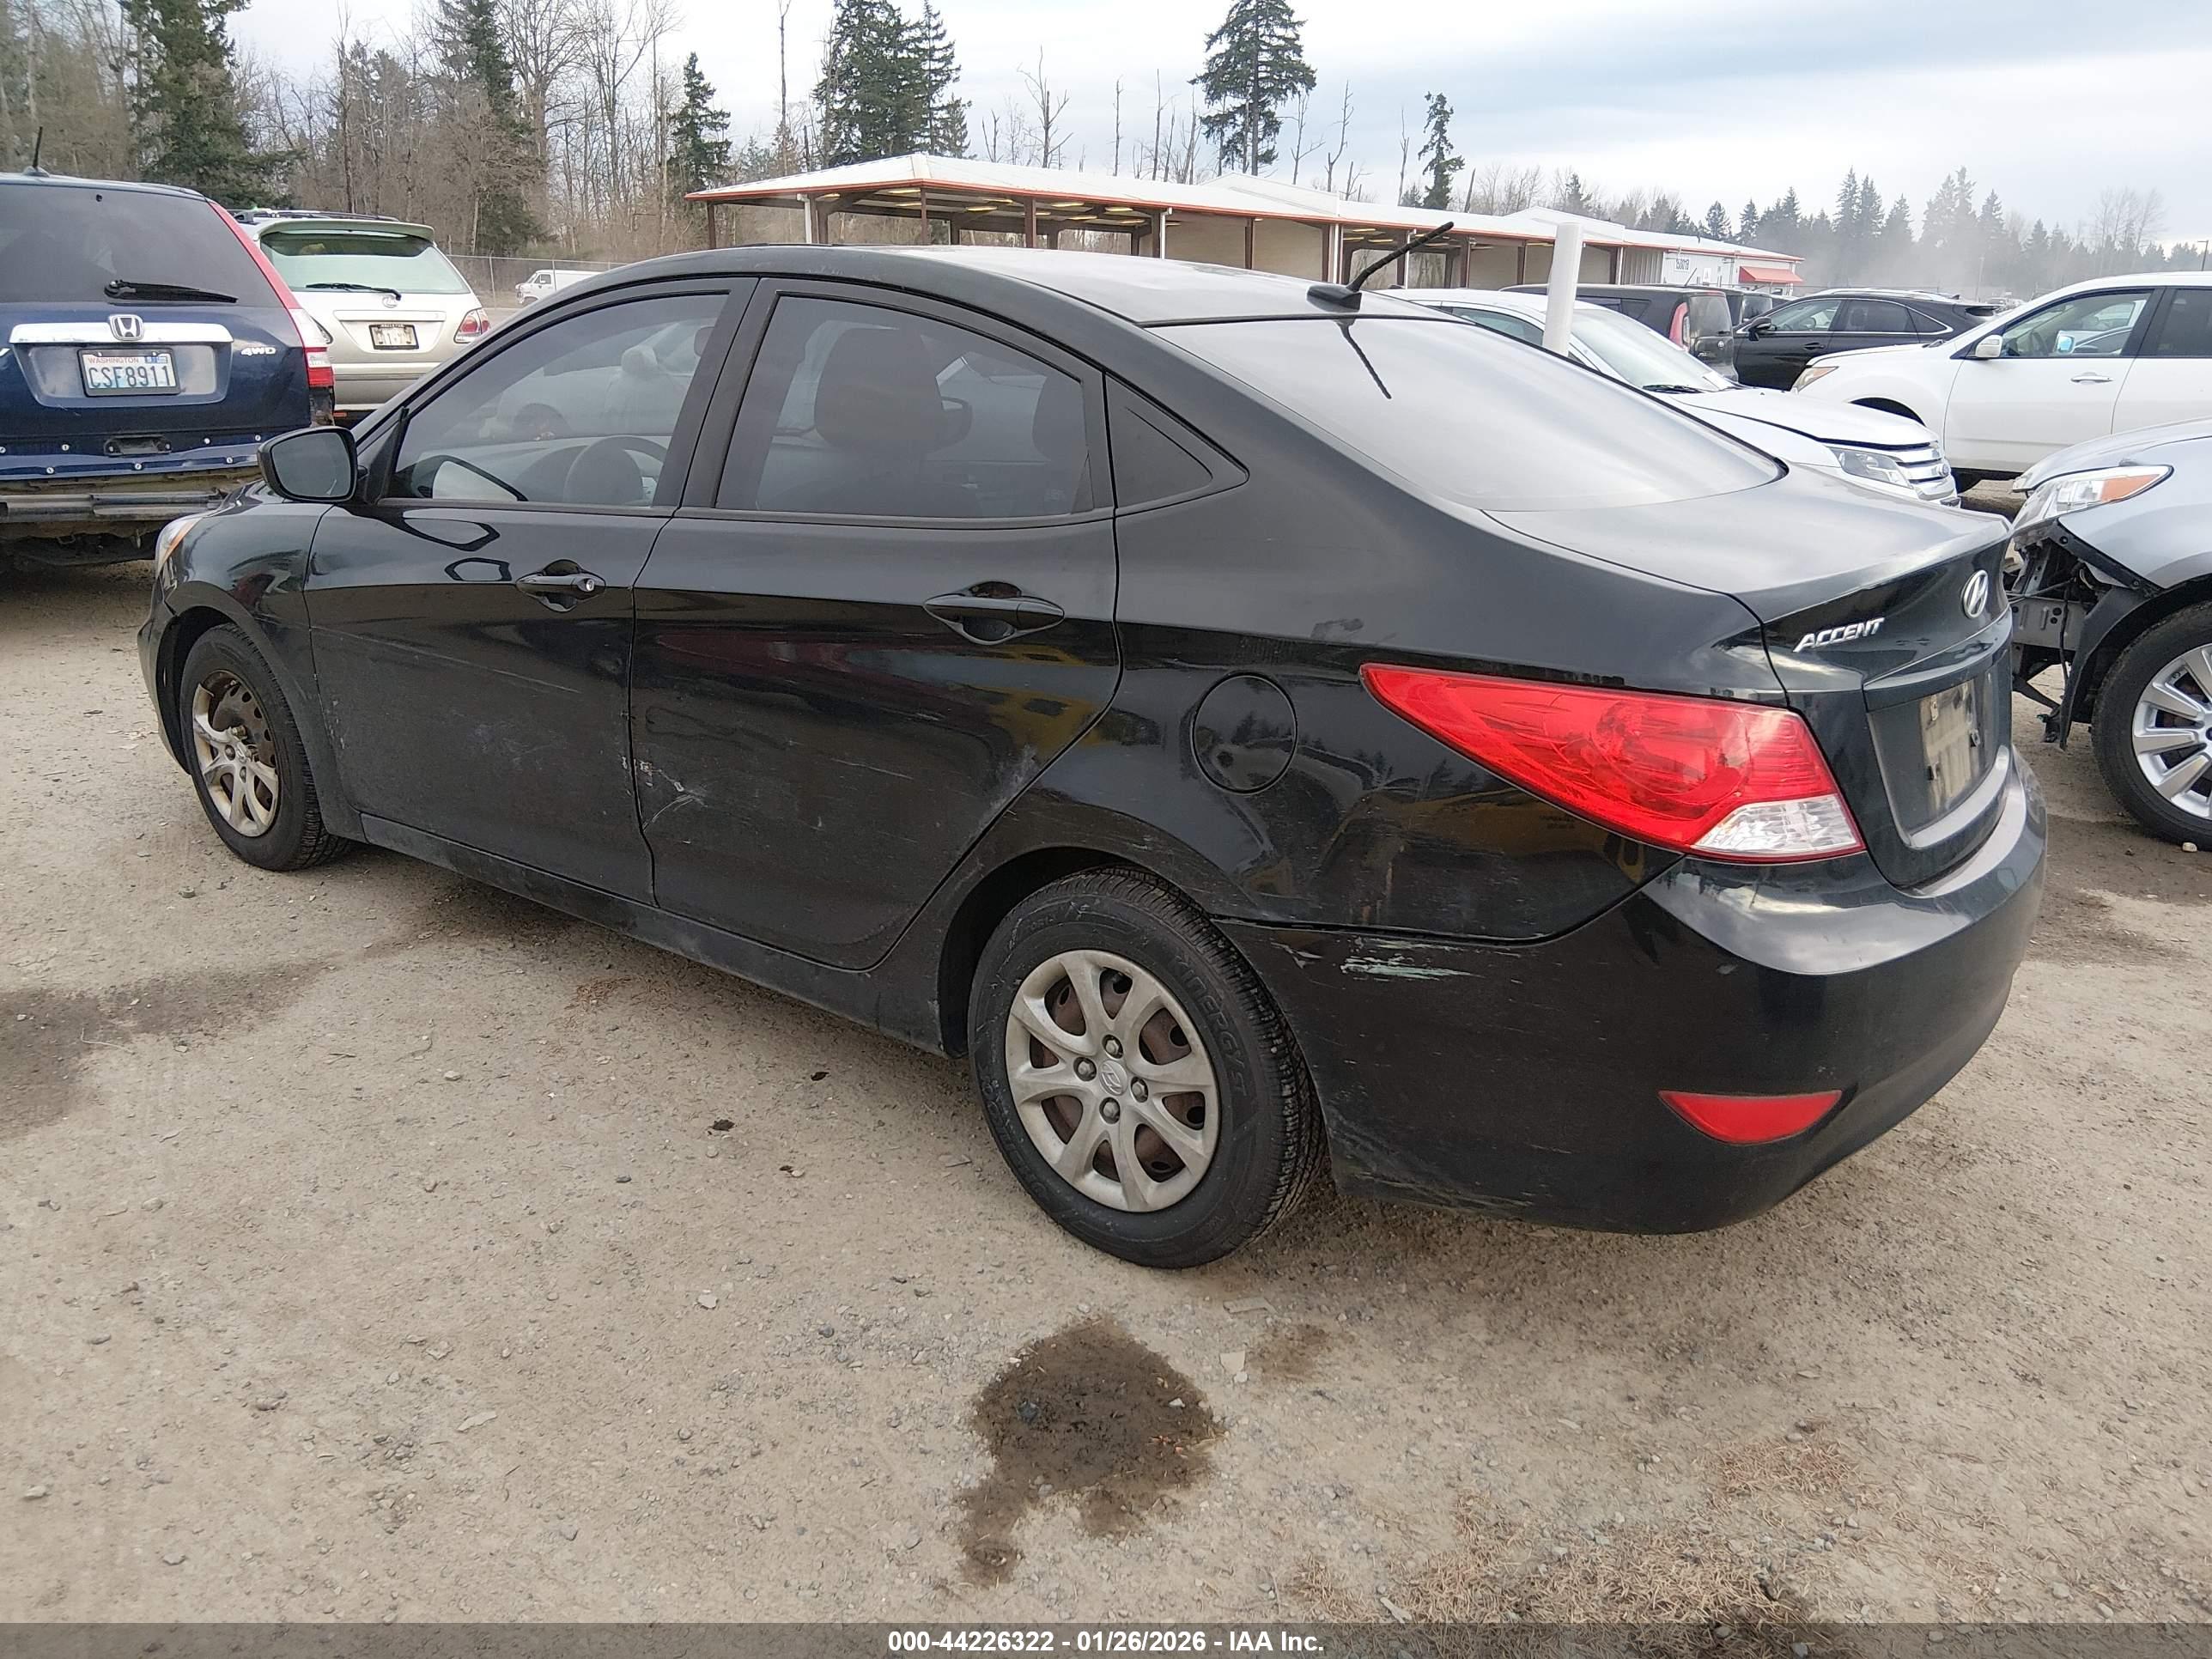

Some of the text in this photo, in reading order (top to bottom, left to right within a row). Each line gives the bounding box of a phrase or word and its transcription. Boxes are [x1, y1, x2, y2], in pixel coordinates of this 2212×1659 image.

[241, 347, 276, 356] 4WD
[89, 366, 170, 388] CSF8911
[1792, 617, 1886, 653] ACCENT
